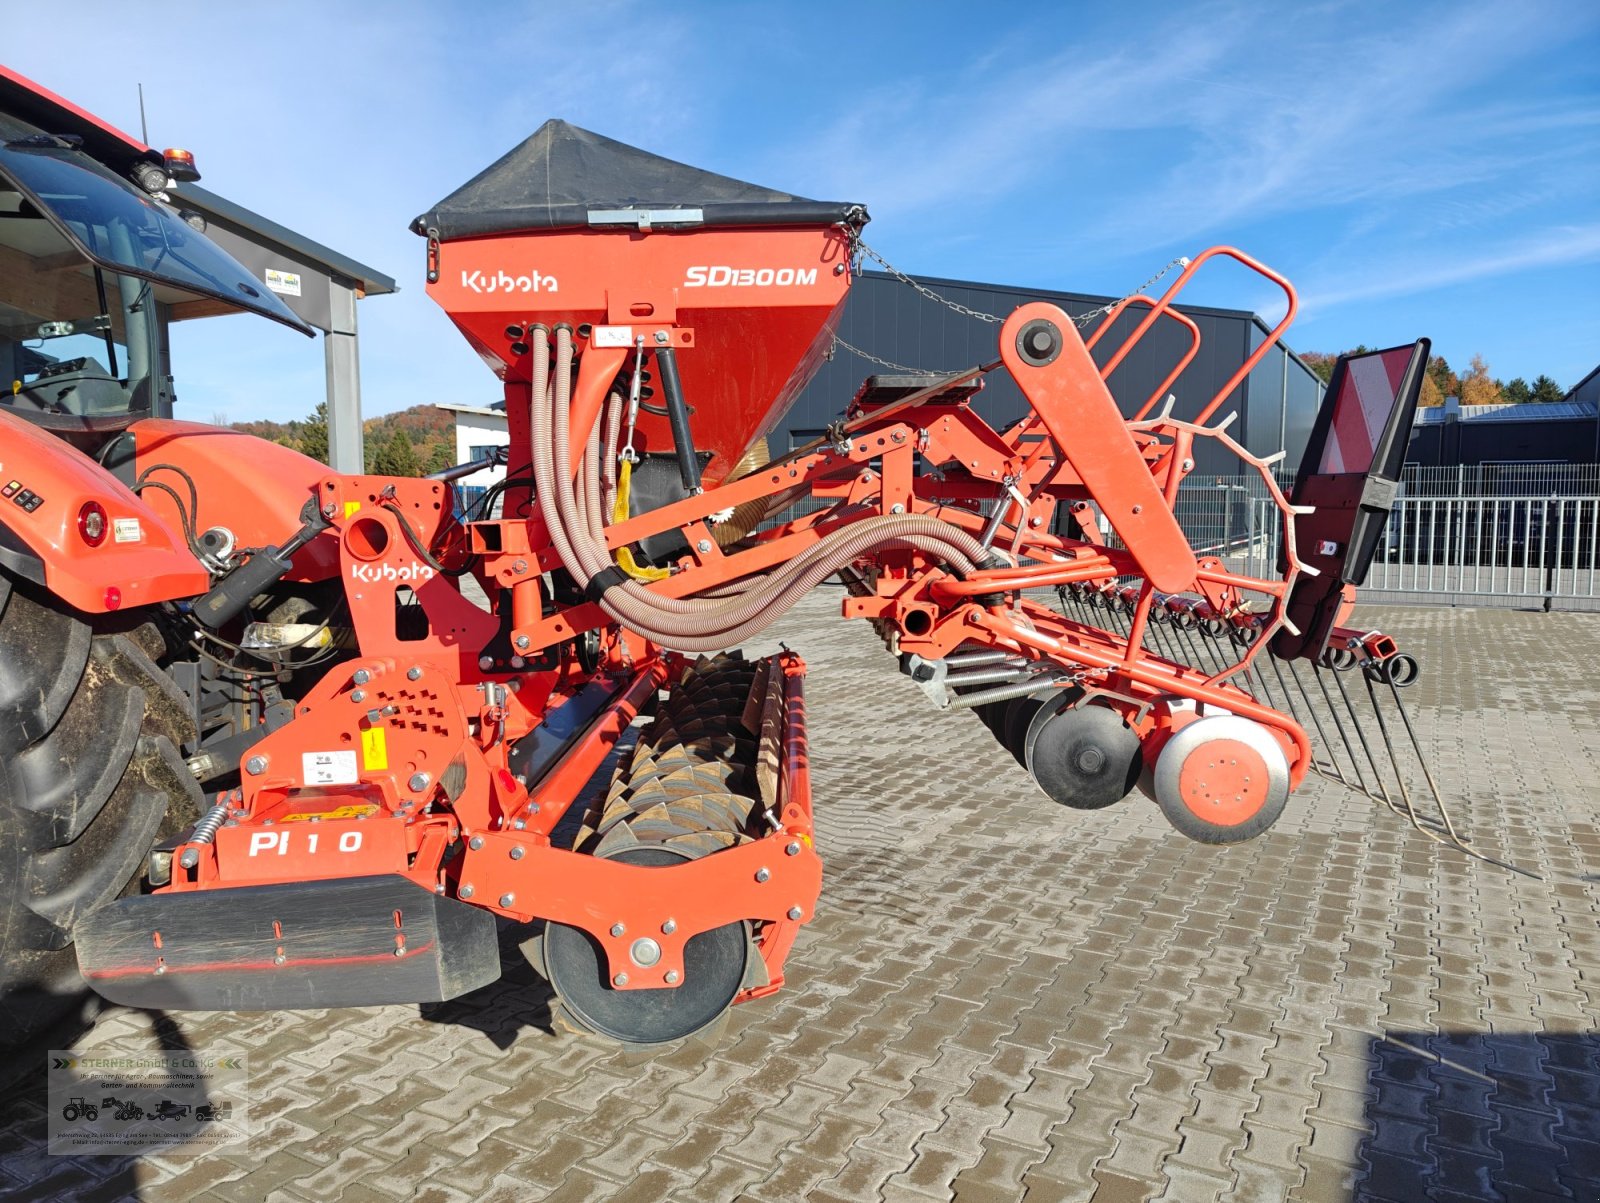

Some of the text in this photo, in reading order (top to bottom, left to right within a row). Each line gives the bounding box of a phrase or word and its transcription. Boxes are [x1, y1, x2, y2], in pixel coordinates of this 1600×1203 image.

[461, 269, 558, 294] Kubota
[683, 265, 818, 289] SD1300M
[351, 559, 434, 583] Kubota
